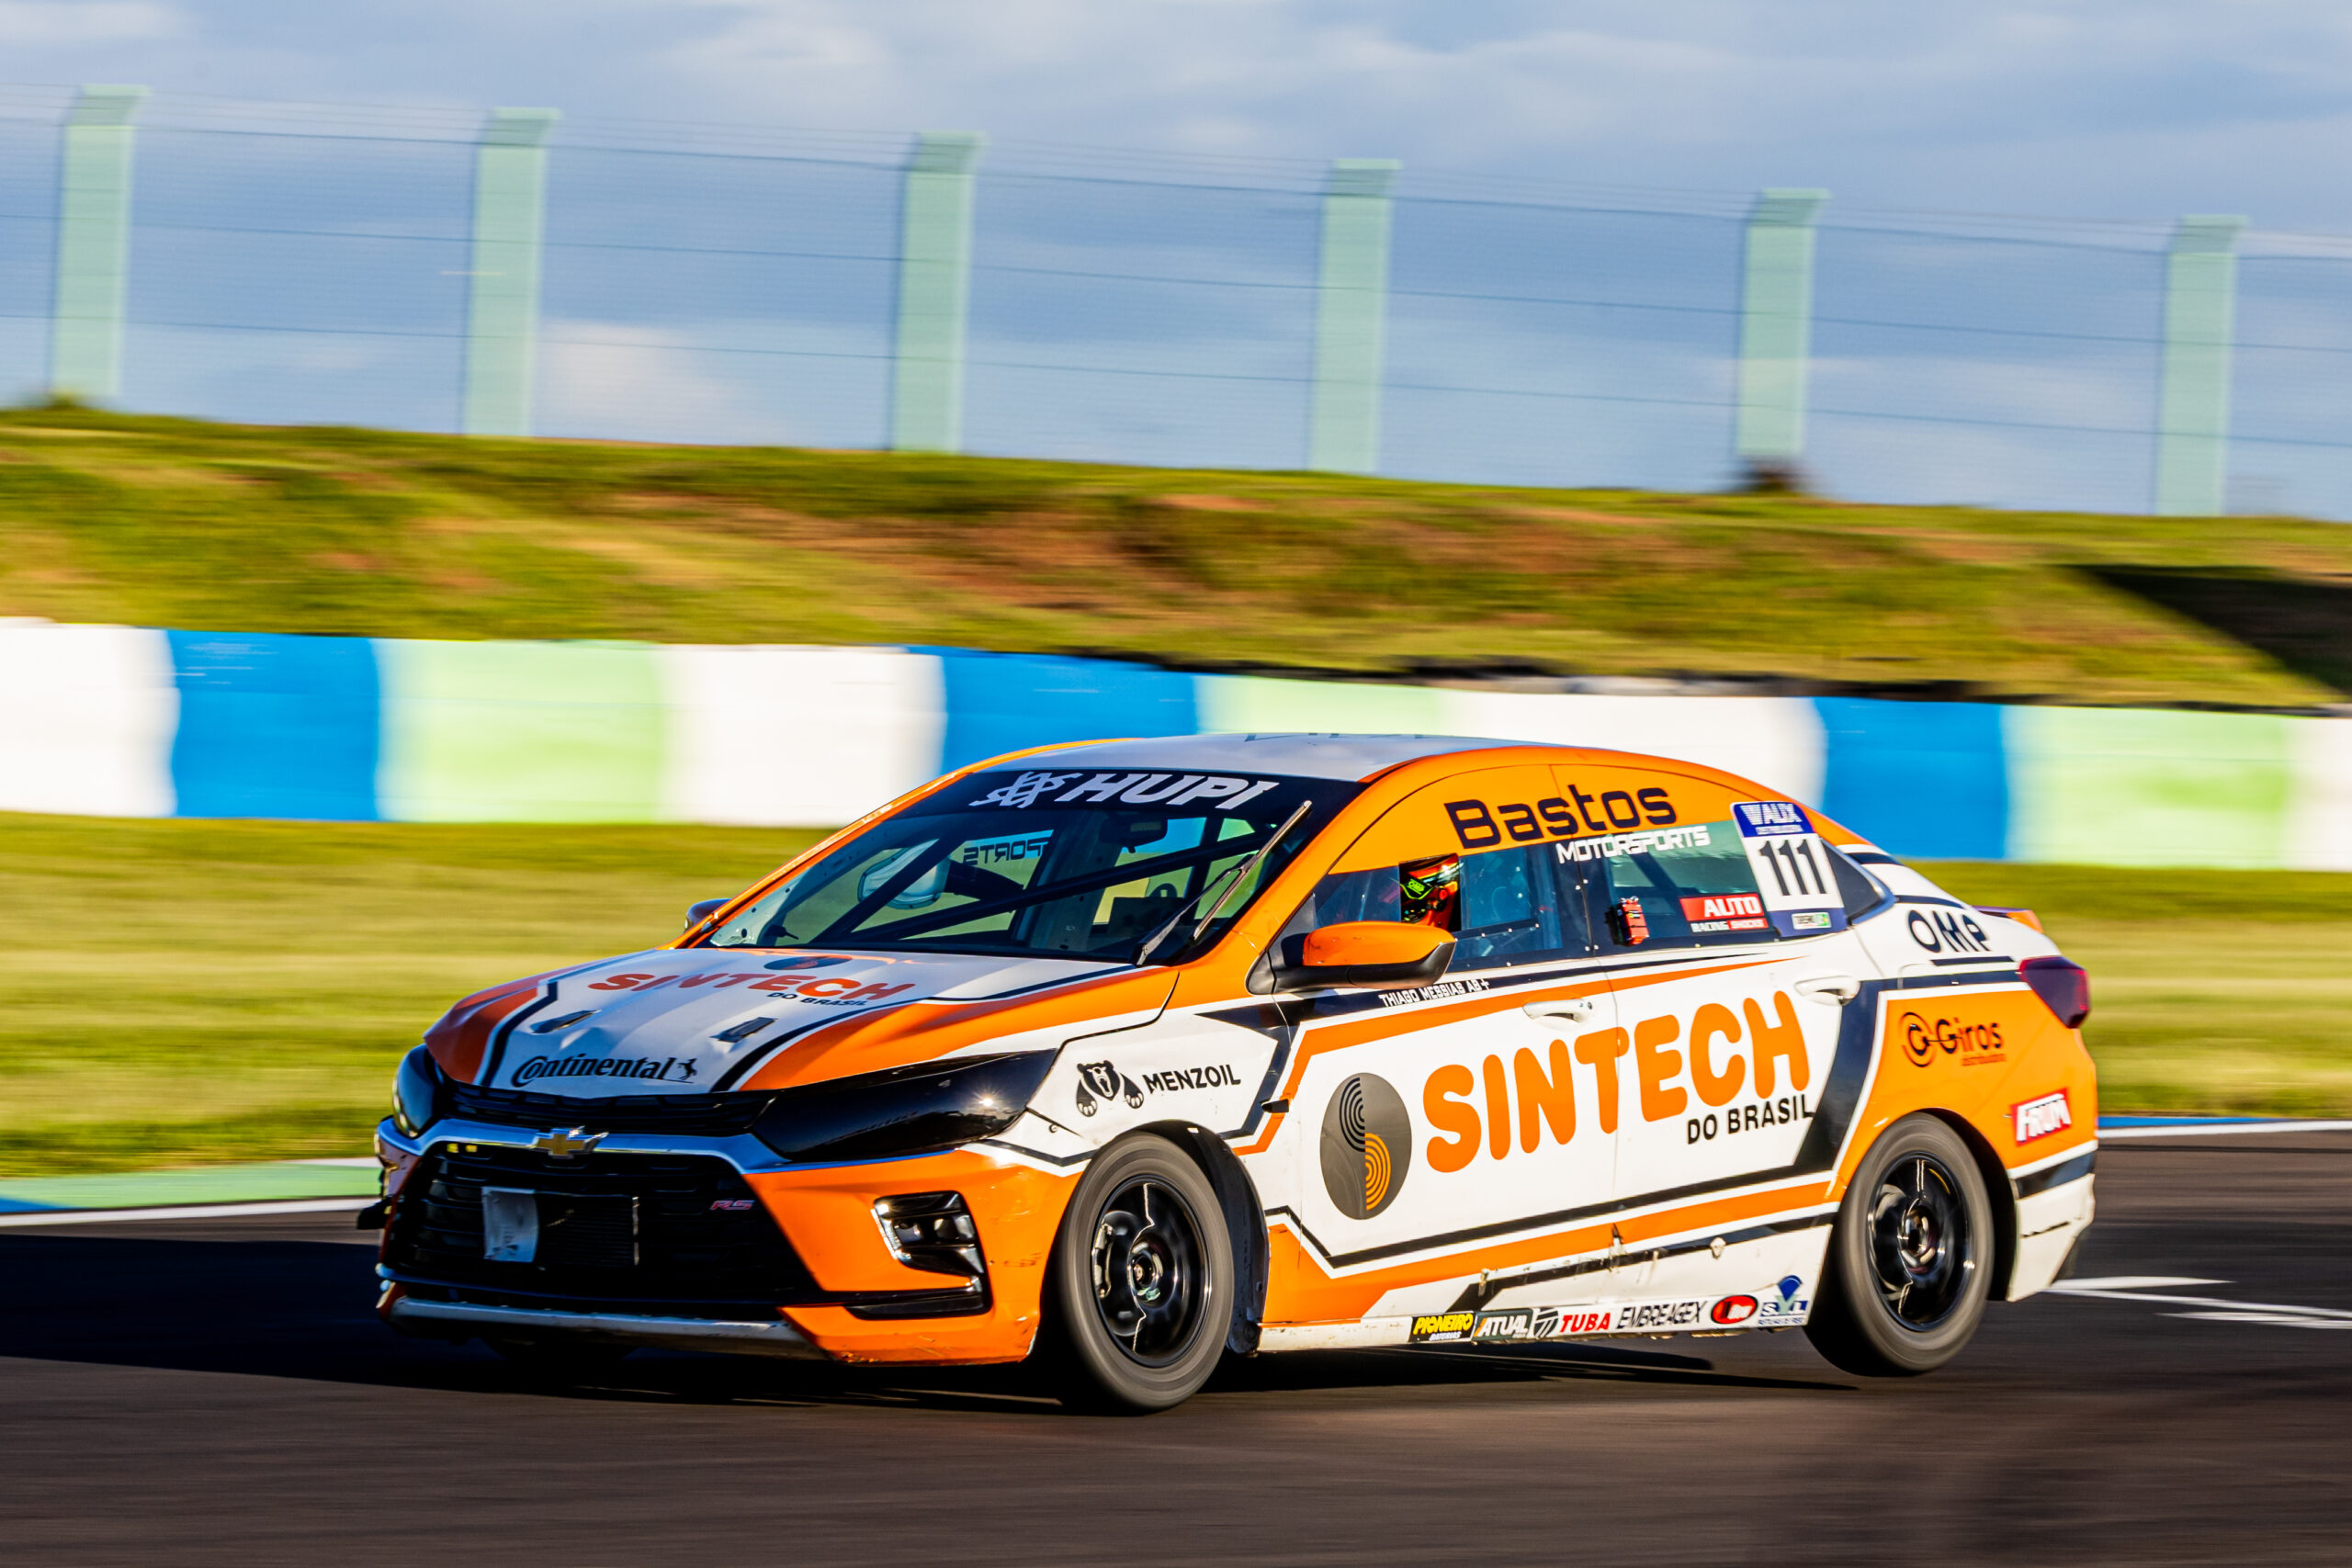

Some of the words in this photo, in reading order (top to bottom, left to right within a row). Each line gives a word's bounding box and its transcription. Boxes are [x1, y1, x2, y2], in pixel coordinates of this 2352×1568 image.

[1055, 773, 1279, 810] HUPI
[1444, 784, 1677, 850] Bastos
[1555, 825, 1711, 864] MOTORSPORTS
[1758, 839, 1827, 897] 111
[1704, 897, 1760, 918] AUTO
[1906, 908, 1992, 953] OMP
[588, 972, 917, 1001] SINTECH
[766, 991, 797, 1000] DO
[800, 996, 867, 1008] BRASIL
[1378, 991, 1420, 1008] THIAGO
[1418, 982, 1466, 1001] MESSIAS
[1936, 1018, 2004, 1055] Giros
[511, 1054, 678, 1088] Continental
[1142, 1064, 1241, 1094] MENZOIL
[1423, 990, 1811, 1173] SINTECH
[1687, 1113, 1718, 1145] DO
[1727, 1094, 1817, 1134] BRASIL
[711, 1199, 754, 1211] RS
[1412, 1313, 1474, 1335] PIONEIRO
[1481, 1314, 1528, 1337] ATUAL
[1561, 1313, 1611, 1333] TUBA
[1617, 1300, 1707, 1329] EMBREAGEX
